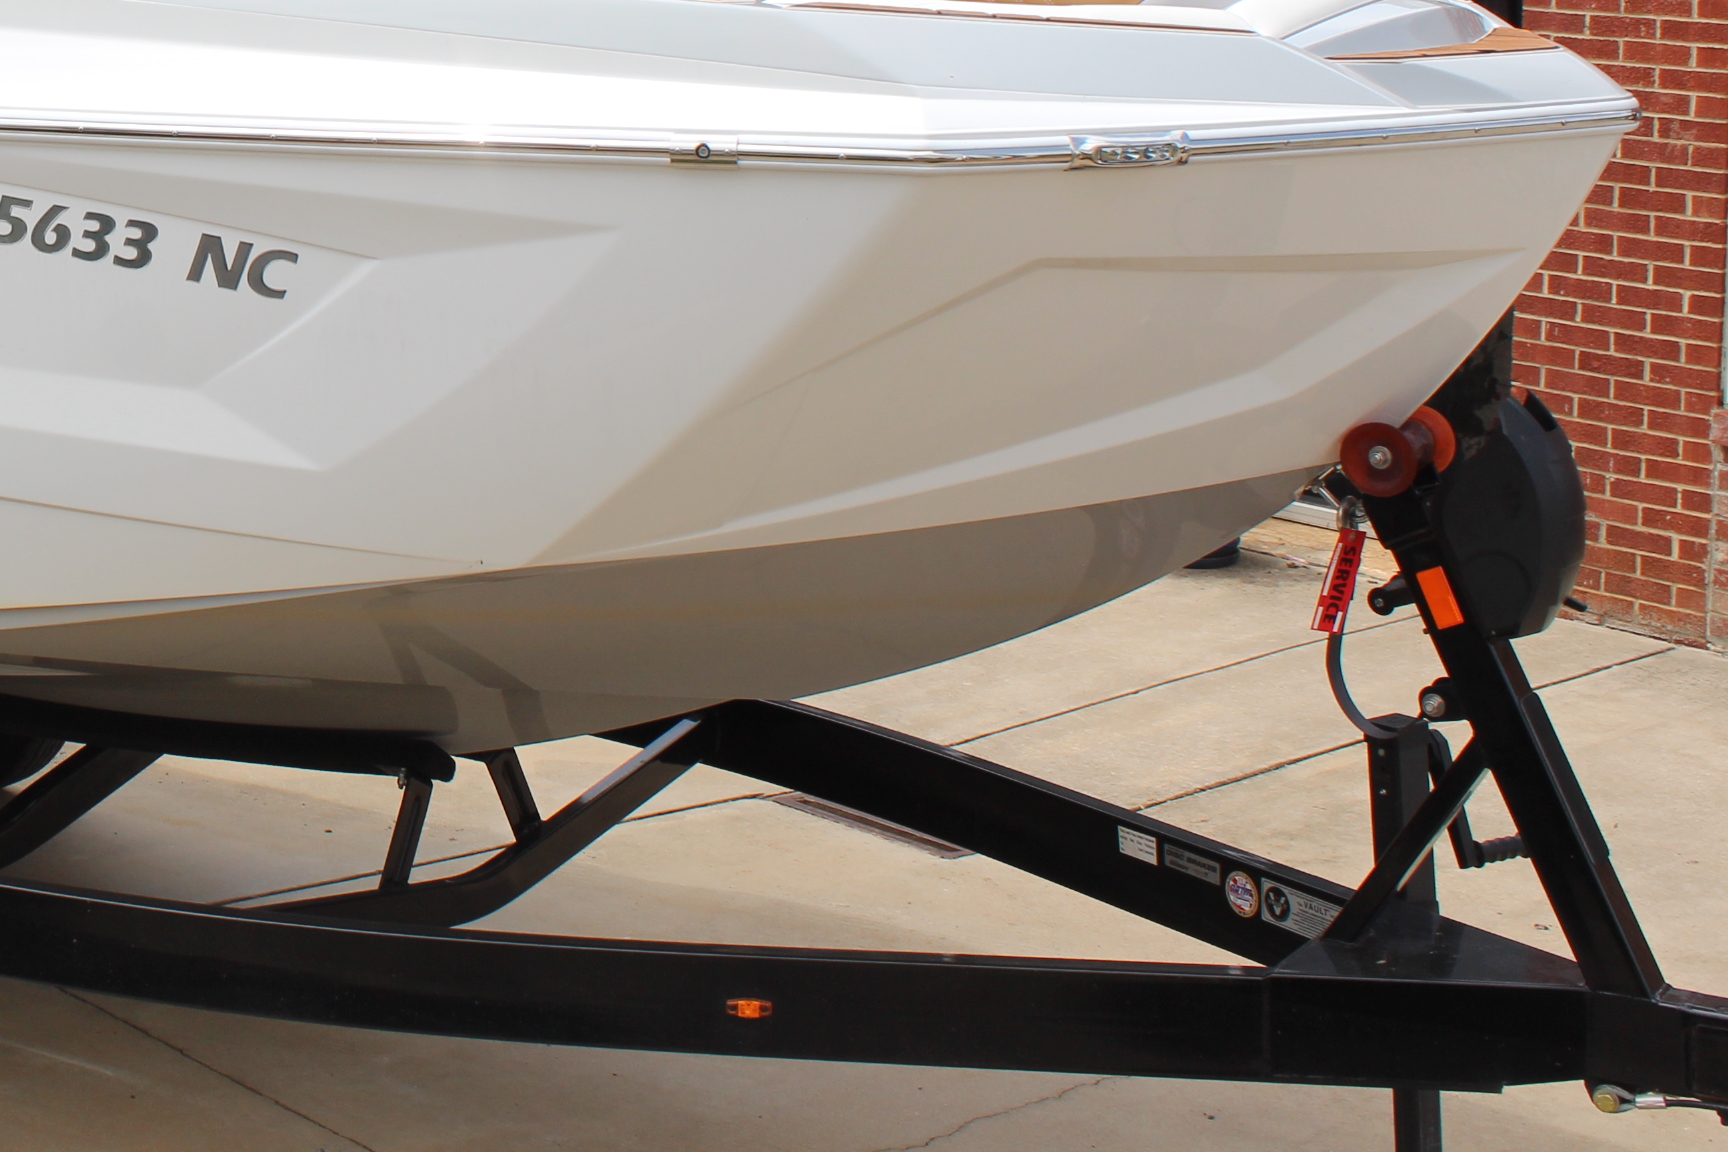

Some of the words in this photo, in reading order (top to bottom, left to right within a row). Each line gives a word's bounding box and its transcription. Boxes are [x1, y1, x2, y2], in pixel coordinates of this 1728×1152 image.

[184, 232, 300, 300] NC
[1323, 545, 1357, 624] SERVICE
[1303, 900, 1329, 916] VAULT
